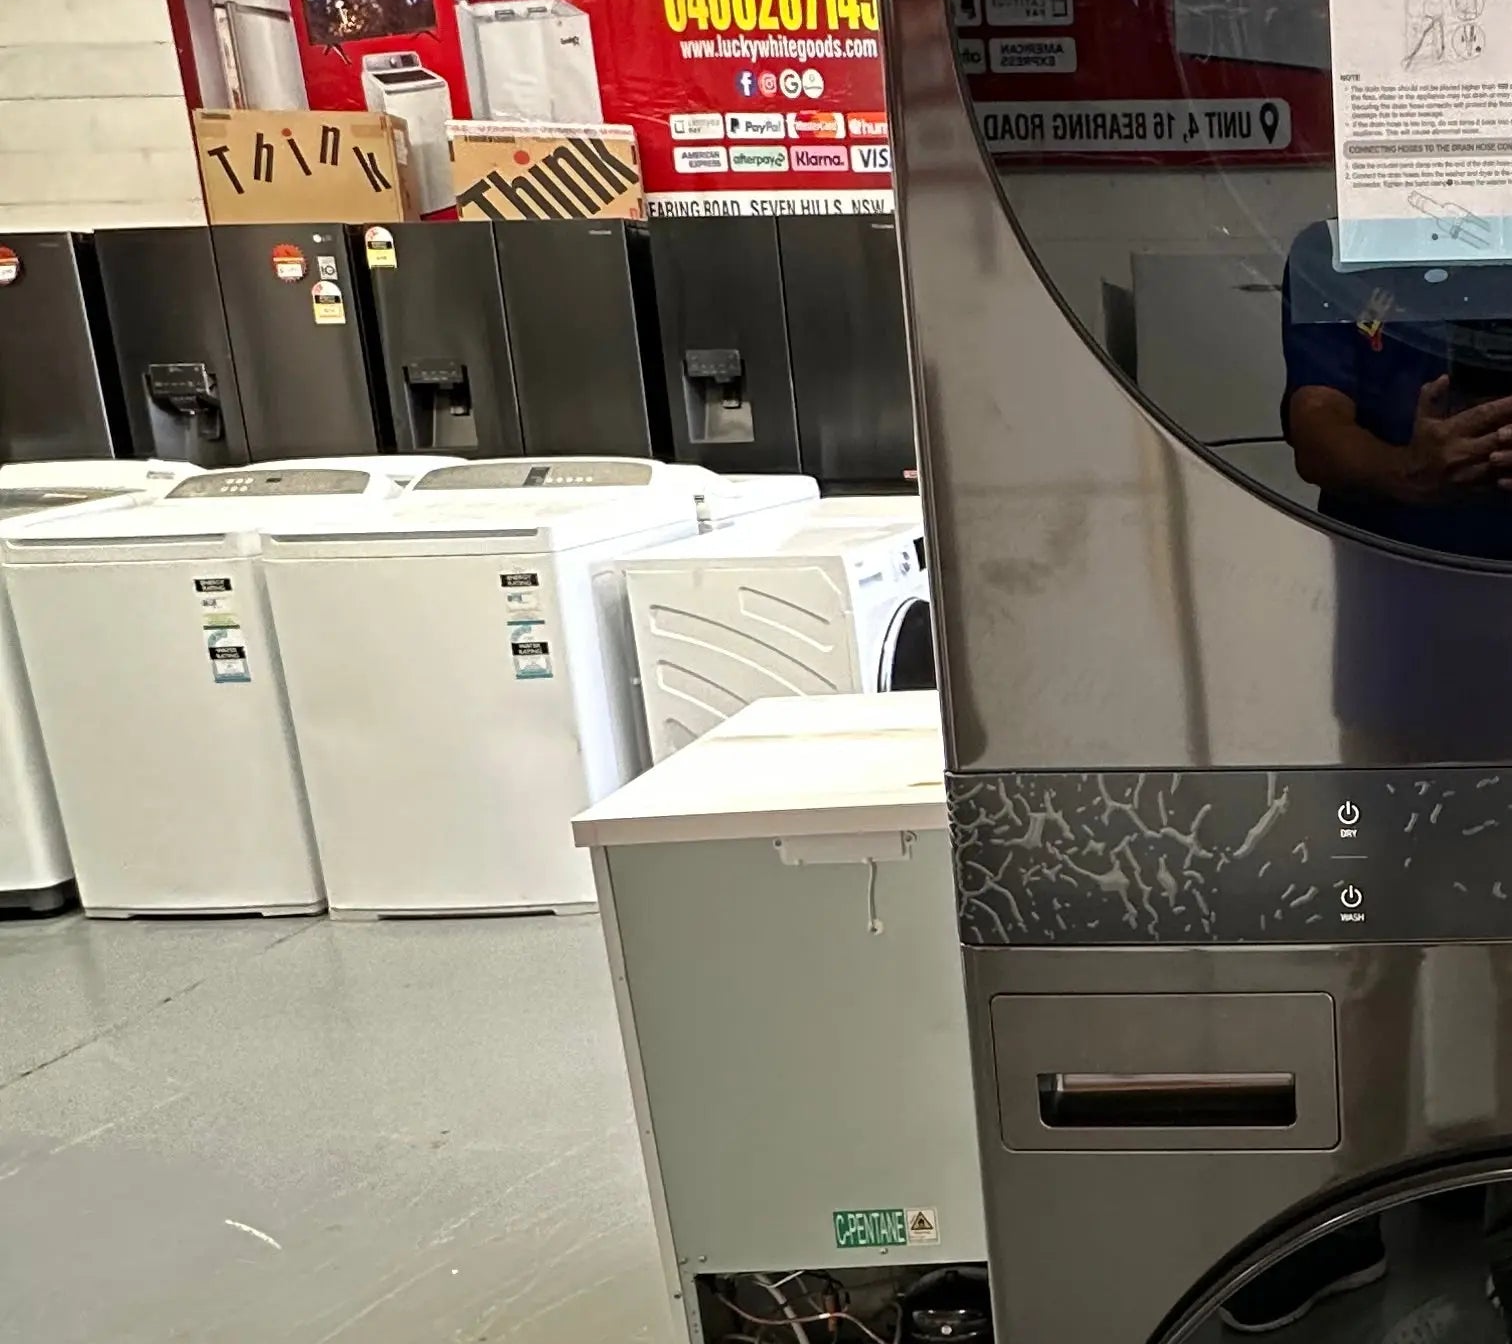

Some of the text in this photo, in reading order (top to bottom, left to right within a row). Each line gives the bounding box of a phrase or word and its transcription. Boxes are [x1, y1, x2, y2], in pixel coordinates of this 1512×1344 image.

[680, 33, 878, 63] www.luckywhitegoods.com
[745, 120, 782, 136] PayPal
[207, 125, 392, 195] Think
[859, 147, 893, 168] VIS
[459, 136, 640, 220] Think
[1340, 828, 1357, 838] DRY
[1340, 913, 1365, 922] WASH
[836, 1212, 905, 1245] C-PENTANE
